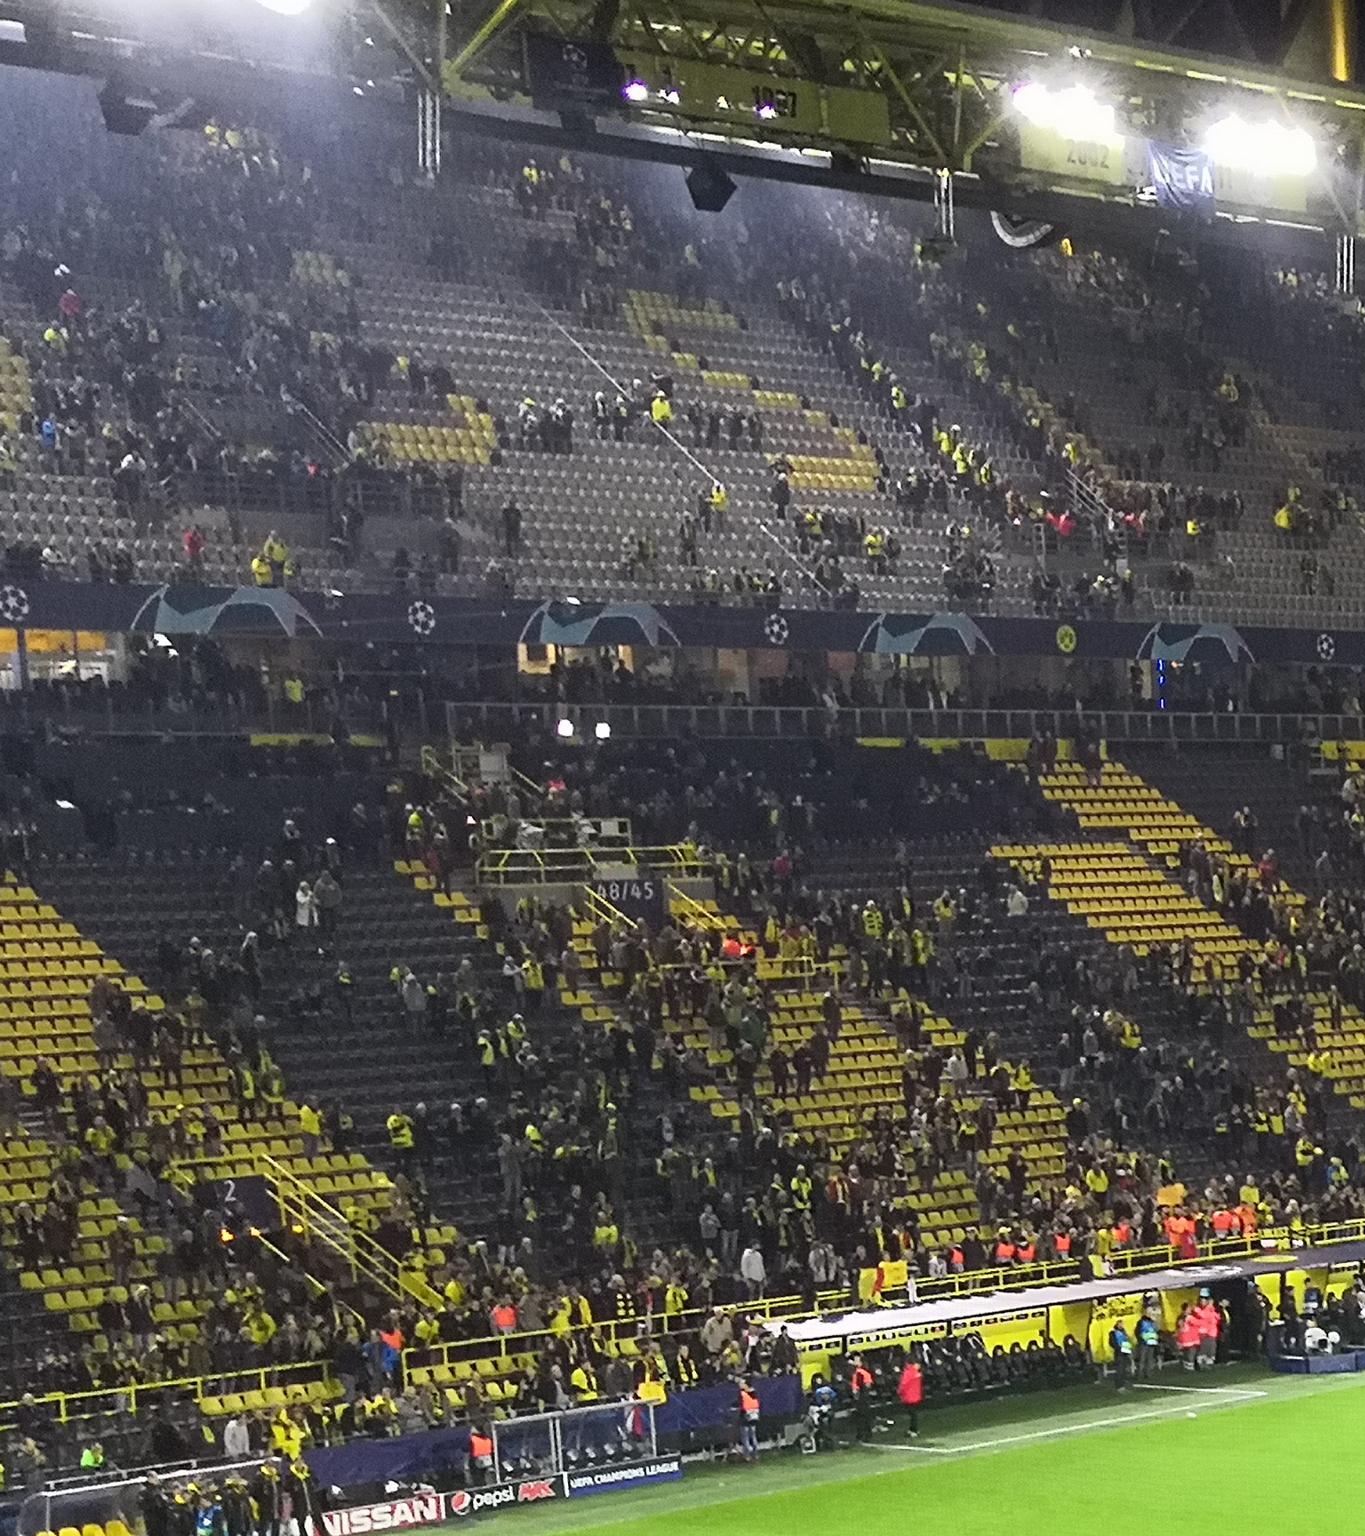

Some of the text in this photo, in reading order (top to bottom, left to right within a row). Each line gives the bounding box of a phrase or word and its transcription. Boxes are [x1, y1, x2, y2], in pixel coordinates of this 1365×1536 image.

[597, 880, 654, 901] 48/45
[224, 1180, 237, 1202] 2
[595, 1466, 645, 1485] CHAMPIONS
[646, 1460, 680, 1476] LEAGUE
[473, 1485, 515, 1510] pepsi
